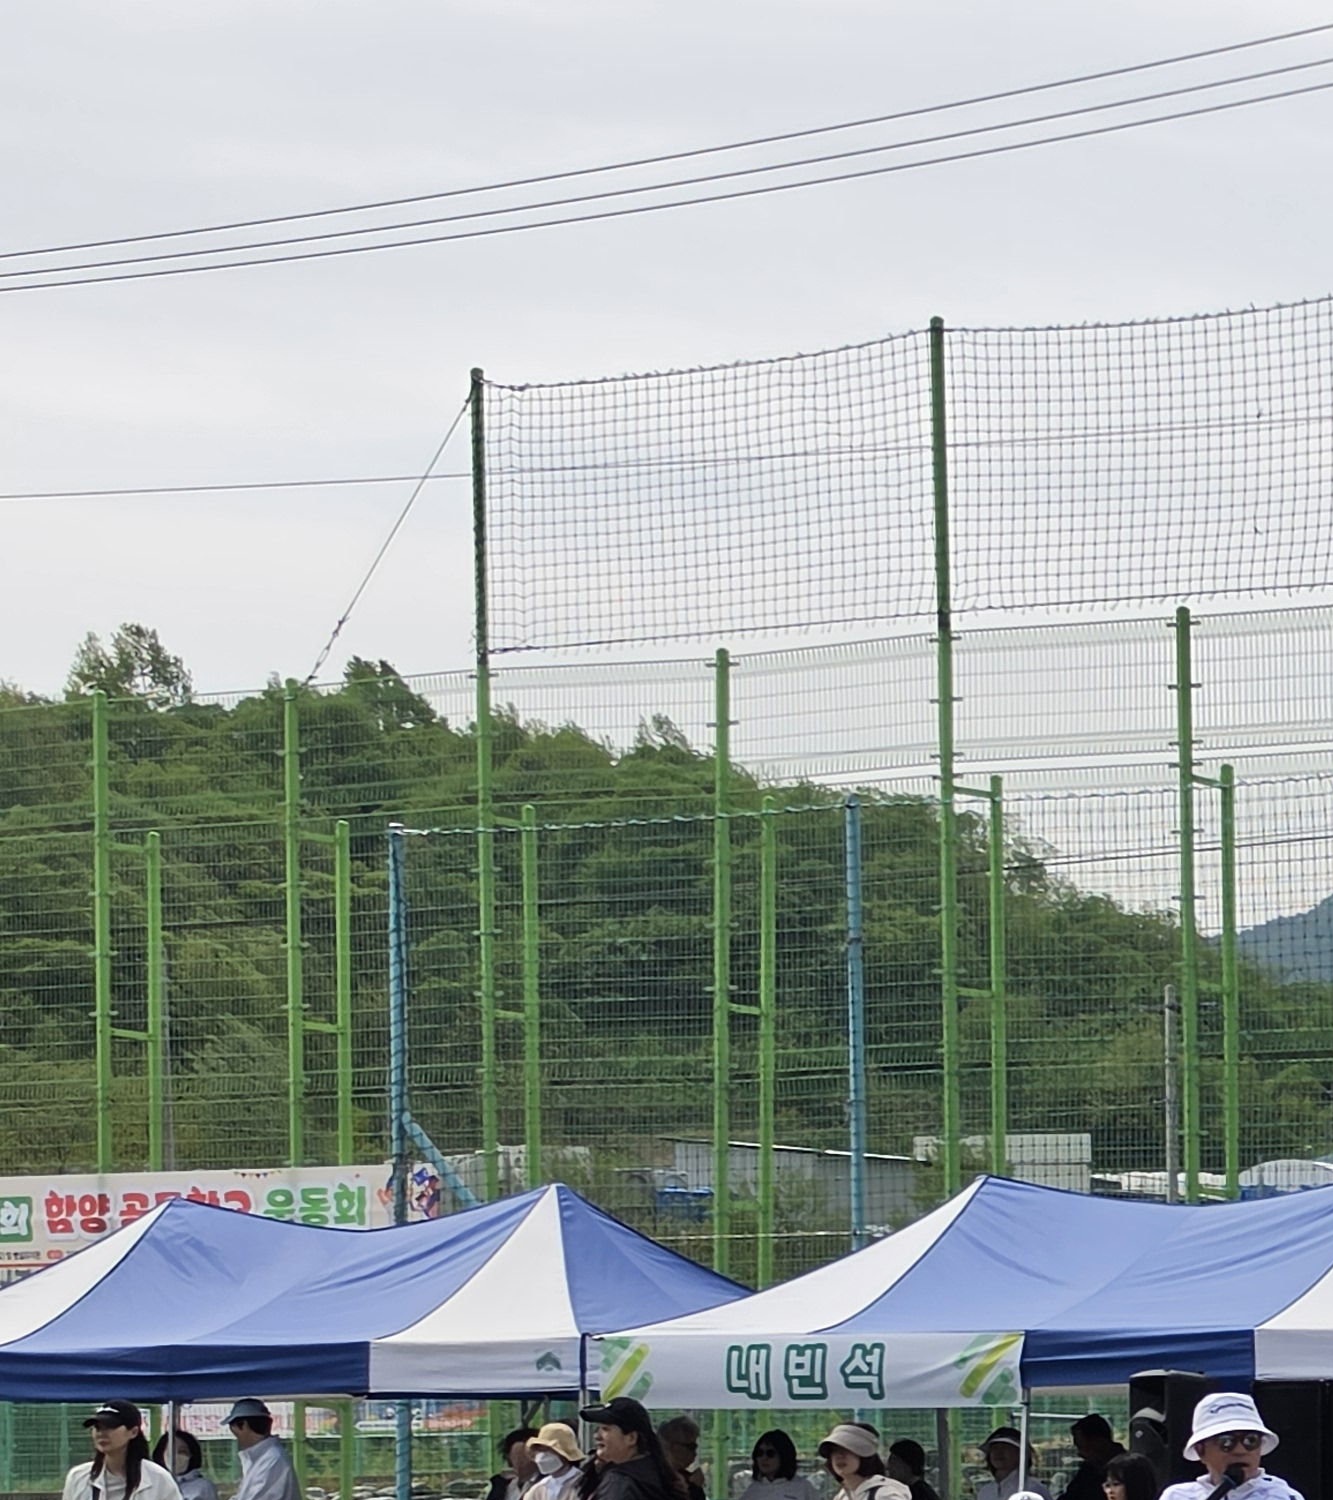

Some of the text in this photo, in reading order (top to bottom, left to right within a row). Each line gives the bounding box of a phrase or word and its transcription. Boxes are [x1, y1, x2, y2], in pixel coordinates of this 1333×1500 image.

[44, 1190, 111, 1234] 함양
[264, 1182, 367, 1227] 운동회
[725, 1342, 886, 1402] 내빈석
